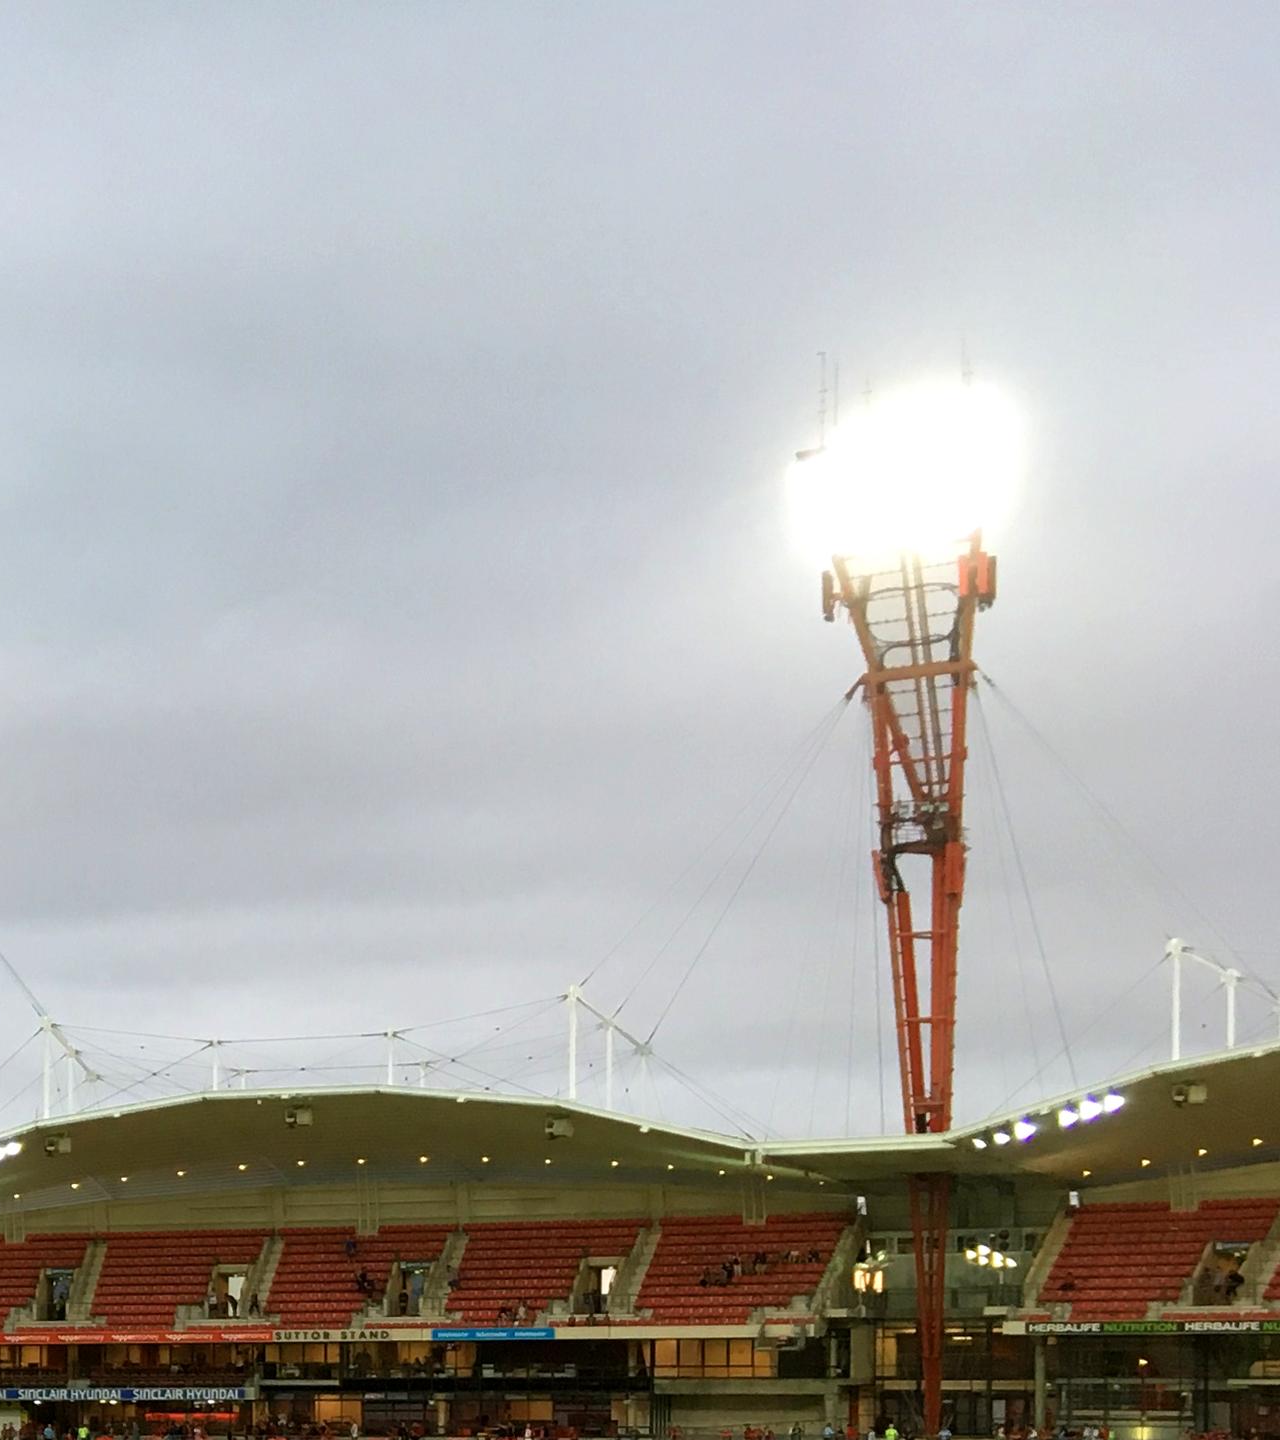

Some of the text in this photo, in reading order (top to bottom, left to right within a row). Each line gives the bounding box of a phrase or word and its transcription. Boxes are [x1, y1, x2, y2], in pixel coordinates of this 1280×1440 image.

[1028, 1323, 1101, 1333] HERBALIFE
[1103, 1323, 1177, 1332] NUTRITION
[1184, 1322, 1260, 1332] HERBALIFE
[275, 1332, 330, 1340] SUTTOR
[340, 1331, 390, 1339] STAND
[17, 1389, 122, 1400] SINCLAIR HYUNDAI
[132, 1388, 238, 1400] SINCLAIR HYUNDAI
